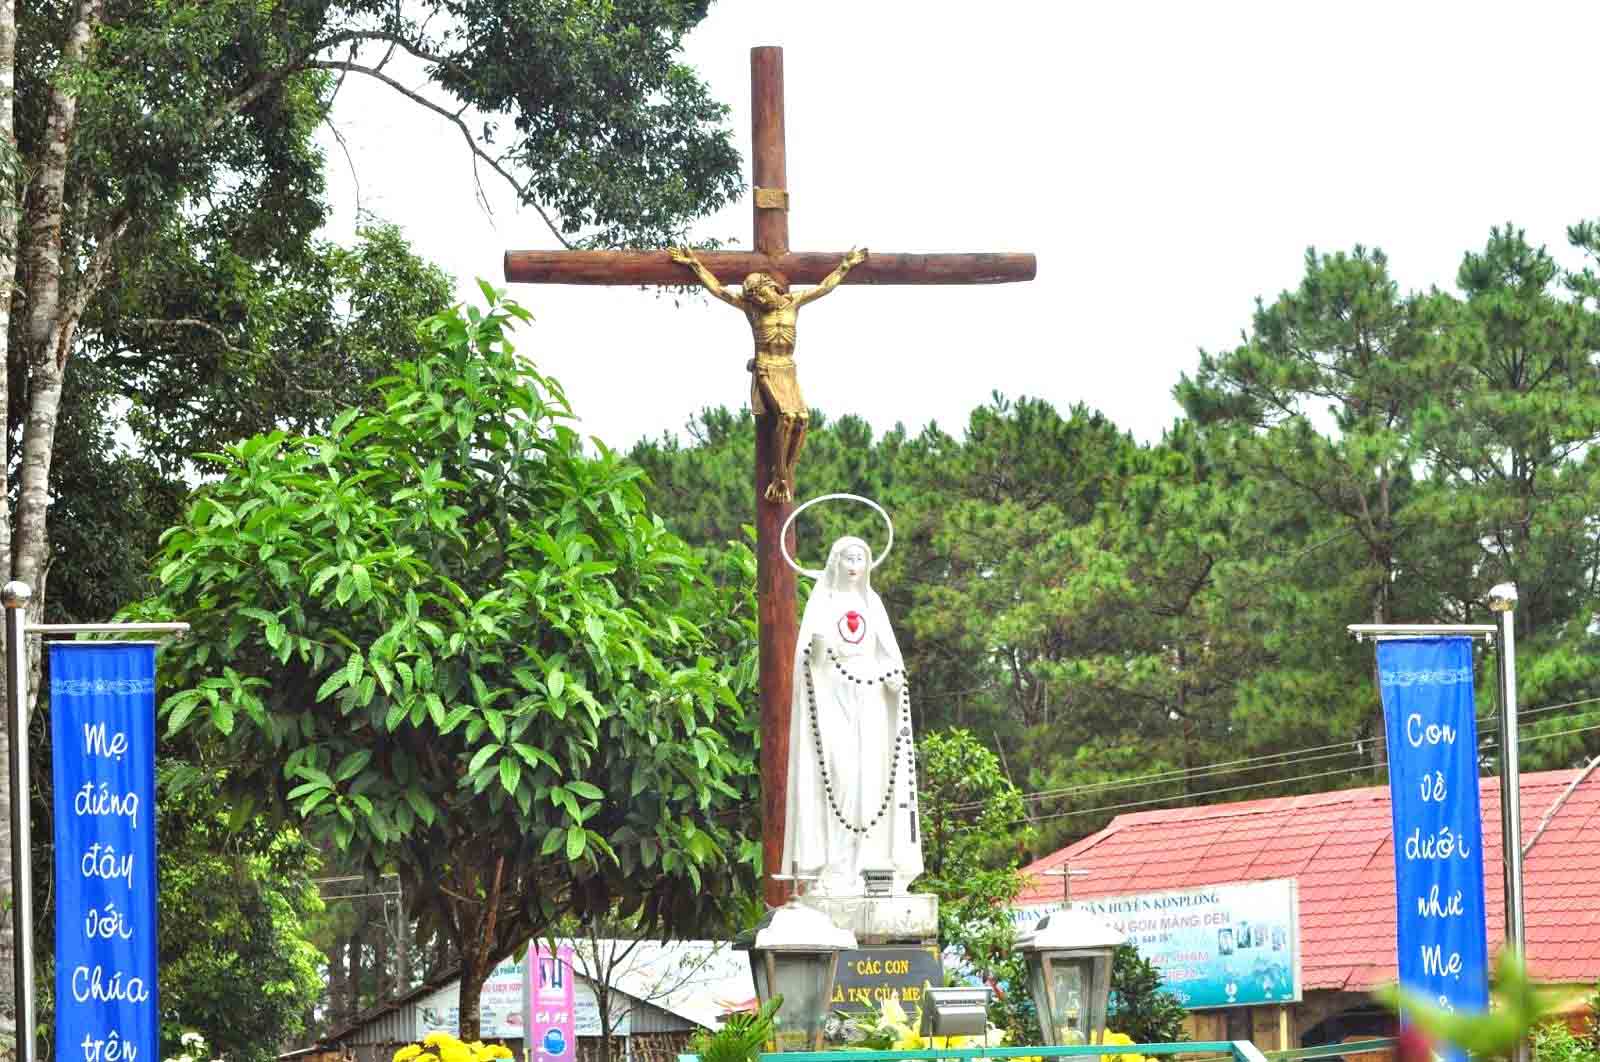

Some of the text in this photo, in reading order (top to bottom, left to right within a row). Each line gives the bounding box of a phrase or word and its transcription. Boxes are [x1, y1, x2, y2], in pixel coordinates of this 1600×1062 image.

[84, 722, 128, 761] Mẹ
[1407, 713, 1456, 747] Con
[1420, 770, 1447, 802] về
[74, 780, 139, 831] đứng
[1405, 826, 1470, 860] dưới
[81, 842, 134, 889] đây
[1417, 884, 1464, 918] như
[85, 902, 132, 939] với
[884, 959, 909, 975] CON
[1420, 944, 1463, 980] Mẹ
[72, 966, 149, 1003] Chúa
[847, 987, 871, 1002] TAY
[81, 1030, 136, 1062] trên
